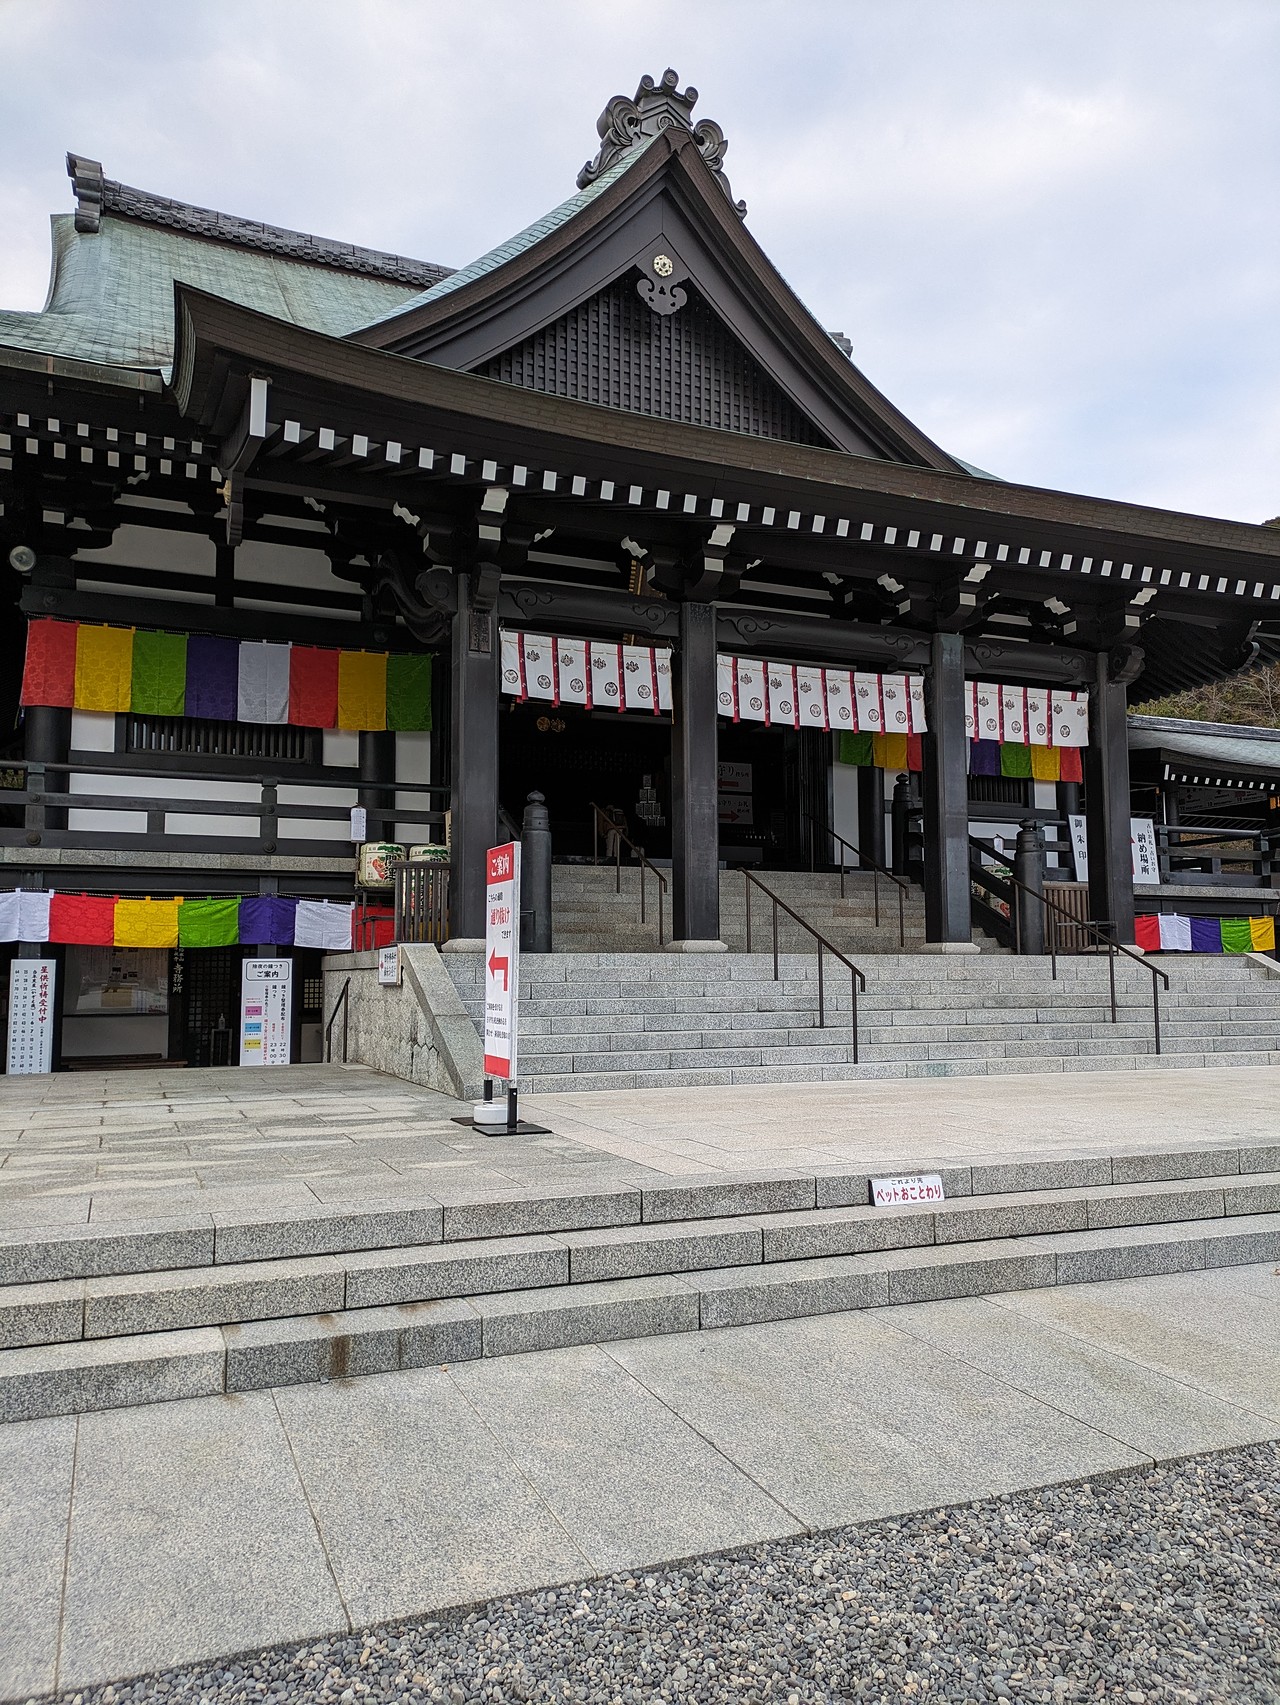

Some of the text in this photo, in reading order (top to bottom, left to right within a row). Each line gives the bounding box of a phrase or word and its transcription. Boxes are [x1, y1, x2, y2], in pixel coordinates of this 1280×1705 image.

[1074, 818, 1087, 860] 御朱印
[1137, 832, 1150, 875] 納め場所
[491, 853, 510, 877] ご案内
[490, 906, 510, 925] 通り抜け
[256, 970, 279, 978] ご案内
[876, 1185, 941, 1202] ペットおことわり
